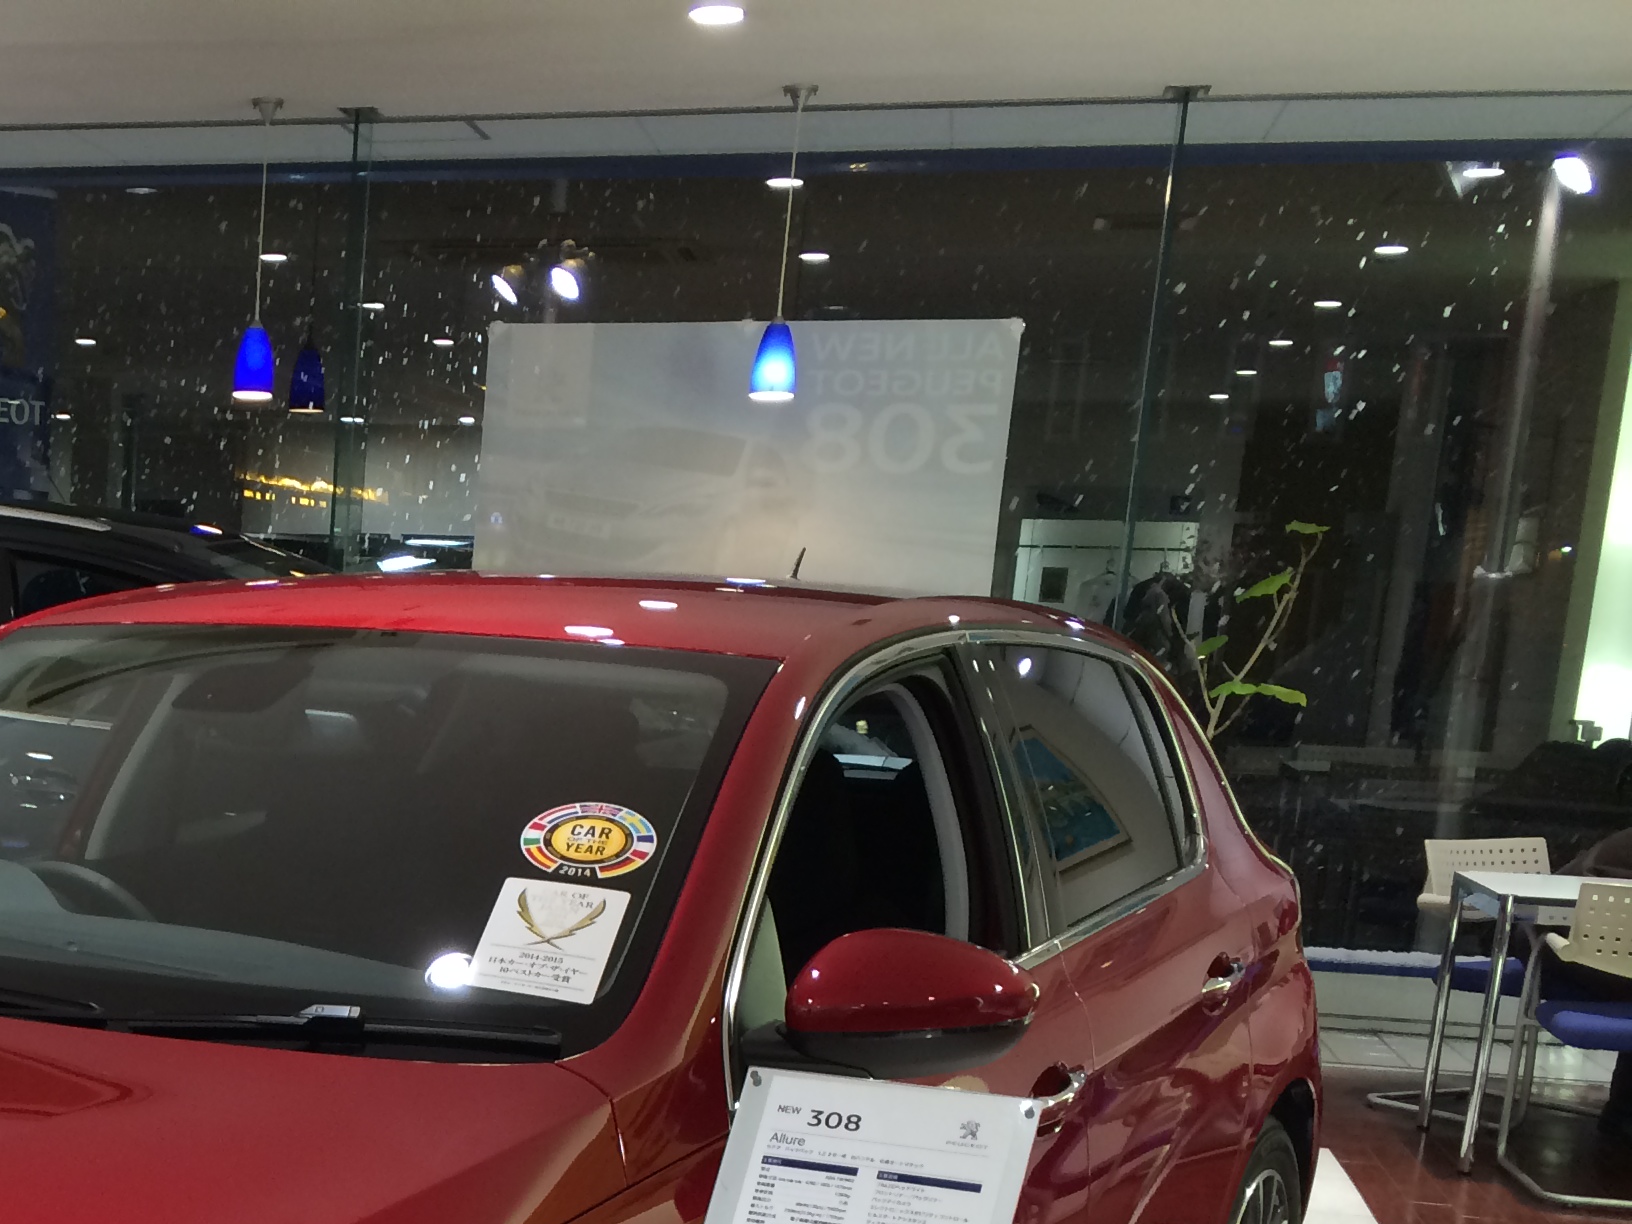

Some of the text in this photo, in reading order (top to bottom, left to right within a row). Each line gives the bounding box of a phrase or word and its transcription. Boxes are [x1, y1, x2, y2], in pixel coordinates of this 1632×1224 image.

[570, 823, 613, 840] CAR
[565, 841, 606, 856] YEAR
[558, 866, 591, 878] 2014
[777, 1104, 862, 1132] NEW 308
[769, 1132, 806, 1147] Allure
